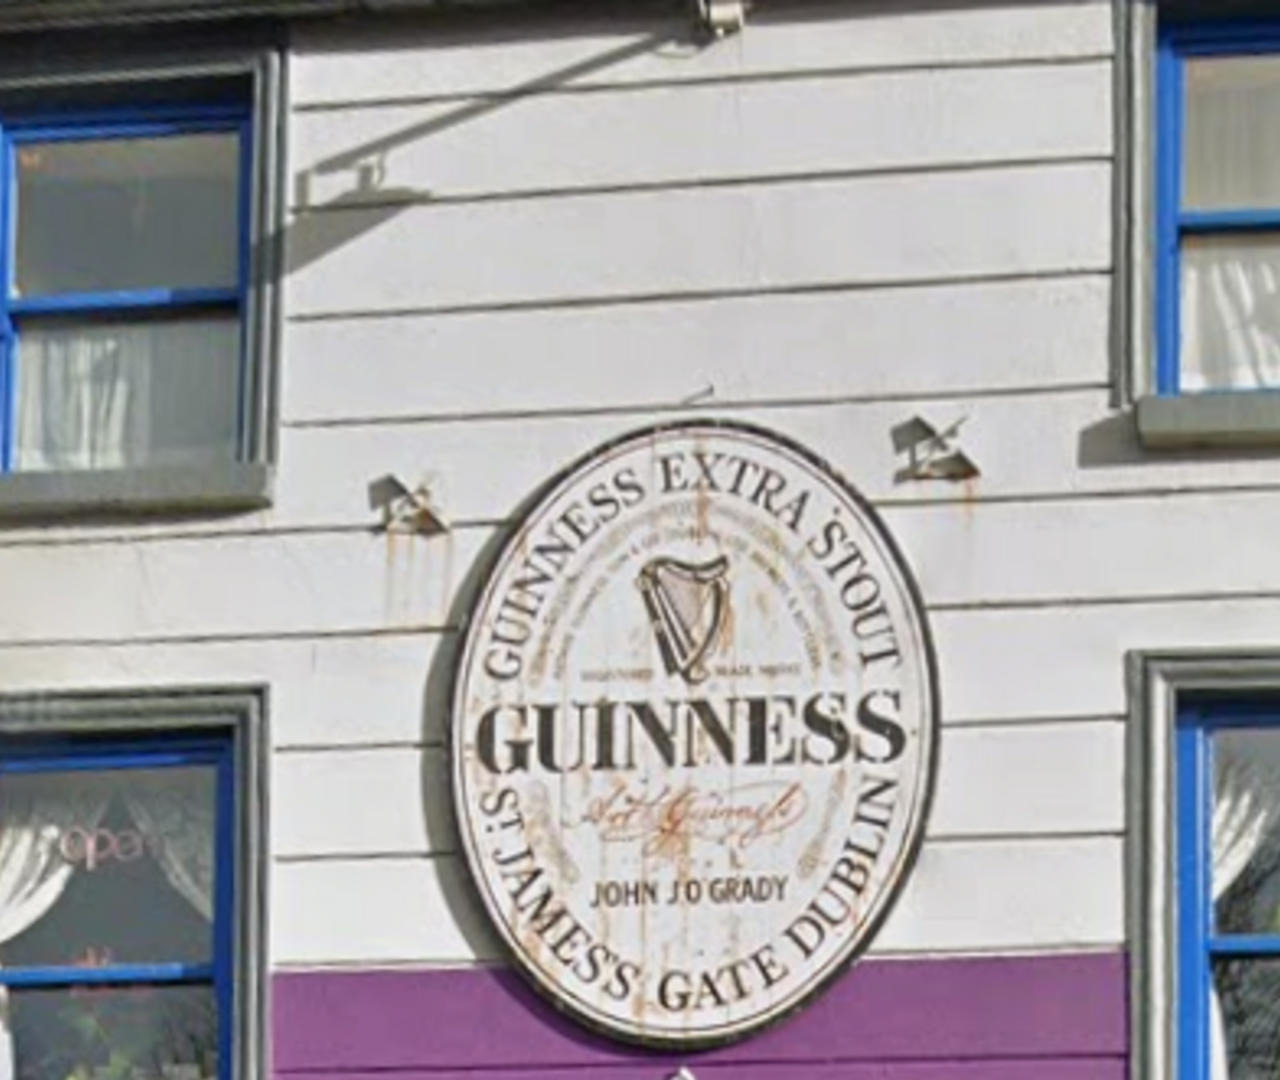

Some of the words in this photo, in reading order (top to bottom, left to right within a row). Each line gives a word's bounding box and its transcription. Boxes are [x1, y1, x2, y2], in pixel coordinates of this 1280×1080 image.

[485, 467, 647, 681] GUINNESS
[656, 452, 815, 535] EXTRA
[809, 518, 904, 671] STOUT
[474, 689, 907, 775] GUINNESS
[590, 880, 658, 908] JOHN
[657, 944, 790, 1013] GATE
[785, 779, 899, 960] DUBLIN
